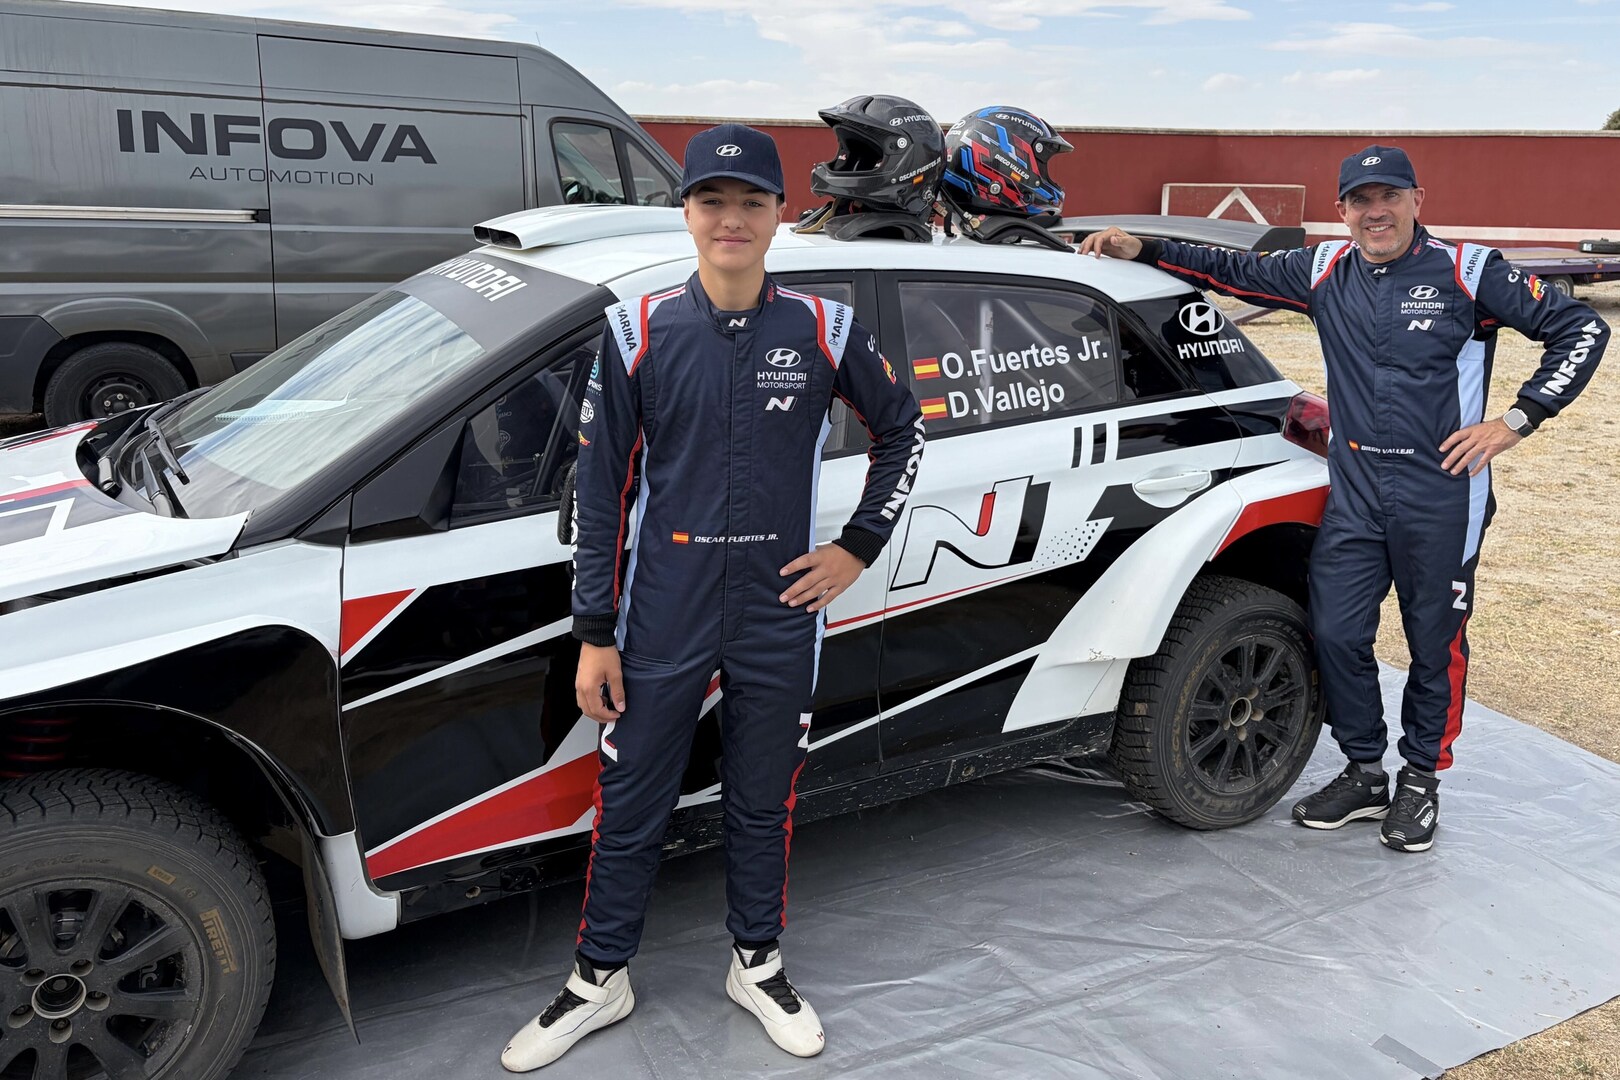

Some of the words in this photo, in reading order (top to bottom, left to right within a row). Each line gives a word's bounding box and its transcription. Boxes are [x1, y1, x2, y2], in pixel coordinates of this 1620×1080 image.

[116, 108, 438, 165] INFOVA
[1010, 116, 1044, 137] HYUNDAI
[189, 166, 374, 186] AUTOMOTION
[898, 170, 916, 182] OSCAR
[916, 159, 937, 175] FUERTES
[994, 153, 1011, 168] DIEGO
[1009, 162, 1030, 180] VALLEJO
[1316, 243, 1332, 274] MARINA
[1463, 247, 1485, 282] MARINA
[615, 304, 637, 352] MARINA
[829, 303, 846, 347] MARINA
[941, 342, 1070, 380] O.Fuertes
[1076, 335, 1109, 363] Jr.
[1176, 338, 1245, 359] HYUNDAI
[756, 371, 808, 382] HYUNDAI
[756, 381, 807, 390] MOTORSPORT
[948, 378, 1066, 419] D.Vallejo
[1360, 445, 1381, 454] DIEGO
[694, 535, 726, 544] OSCAR
[727, 534, 766, 543] FUERTES
[766, 533, 779, 541] JR.
